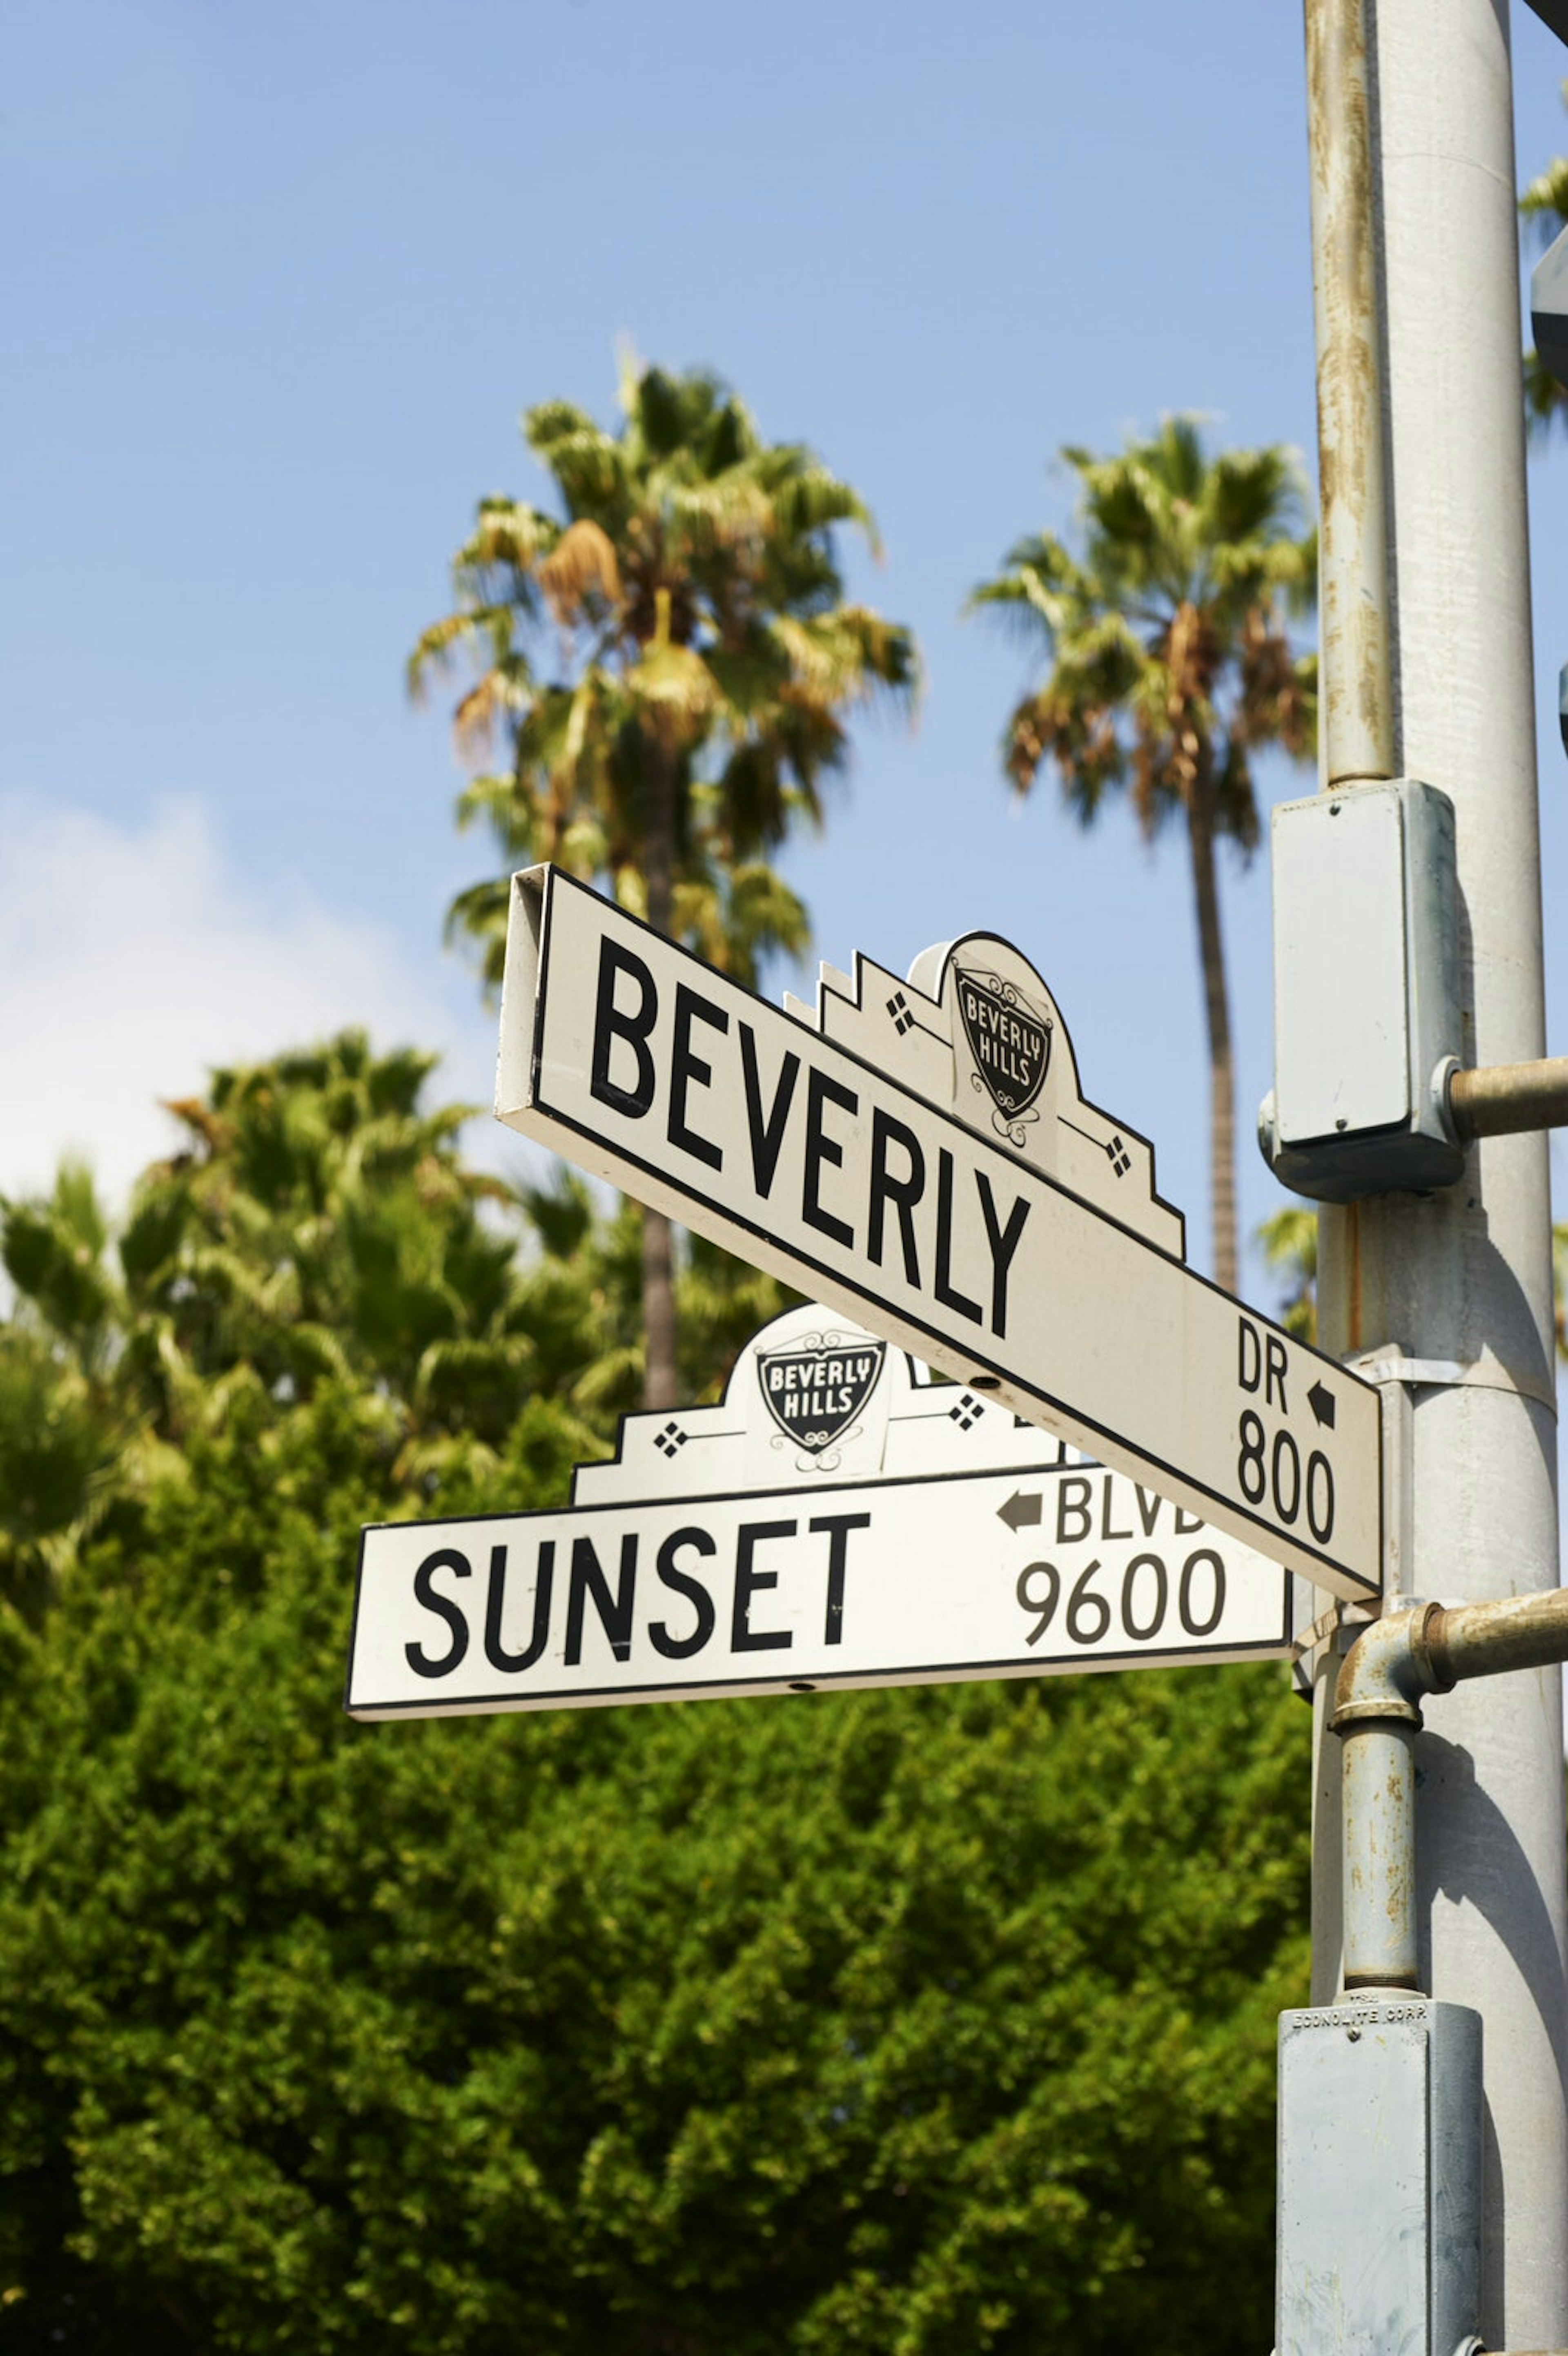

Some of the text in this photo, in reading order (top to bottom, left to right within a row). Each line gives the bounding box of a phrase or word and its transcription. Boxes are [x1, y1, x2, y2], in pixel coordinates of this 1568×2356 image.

[966, 993, 1041, 1061] BEVERLY
[980, 1033, 1030, 1086] HILLS
[590, 934, 1031, 1340] BEVERLY
[770, 1357, 871, 1391] BEVERLY
[784, 1386, 853, 1418] HILLS
[1238, 1316, 1288, 1415] DR
[1238, 1409, 1334, 1545] 800
[405, 1512, 871, 1678] SUNSET
[1017, 1549, 1226, 1646] 9600
[1292, 2010, 1379, 2029] ECONOLITE
